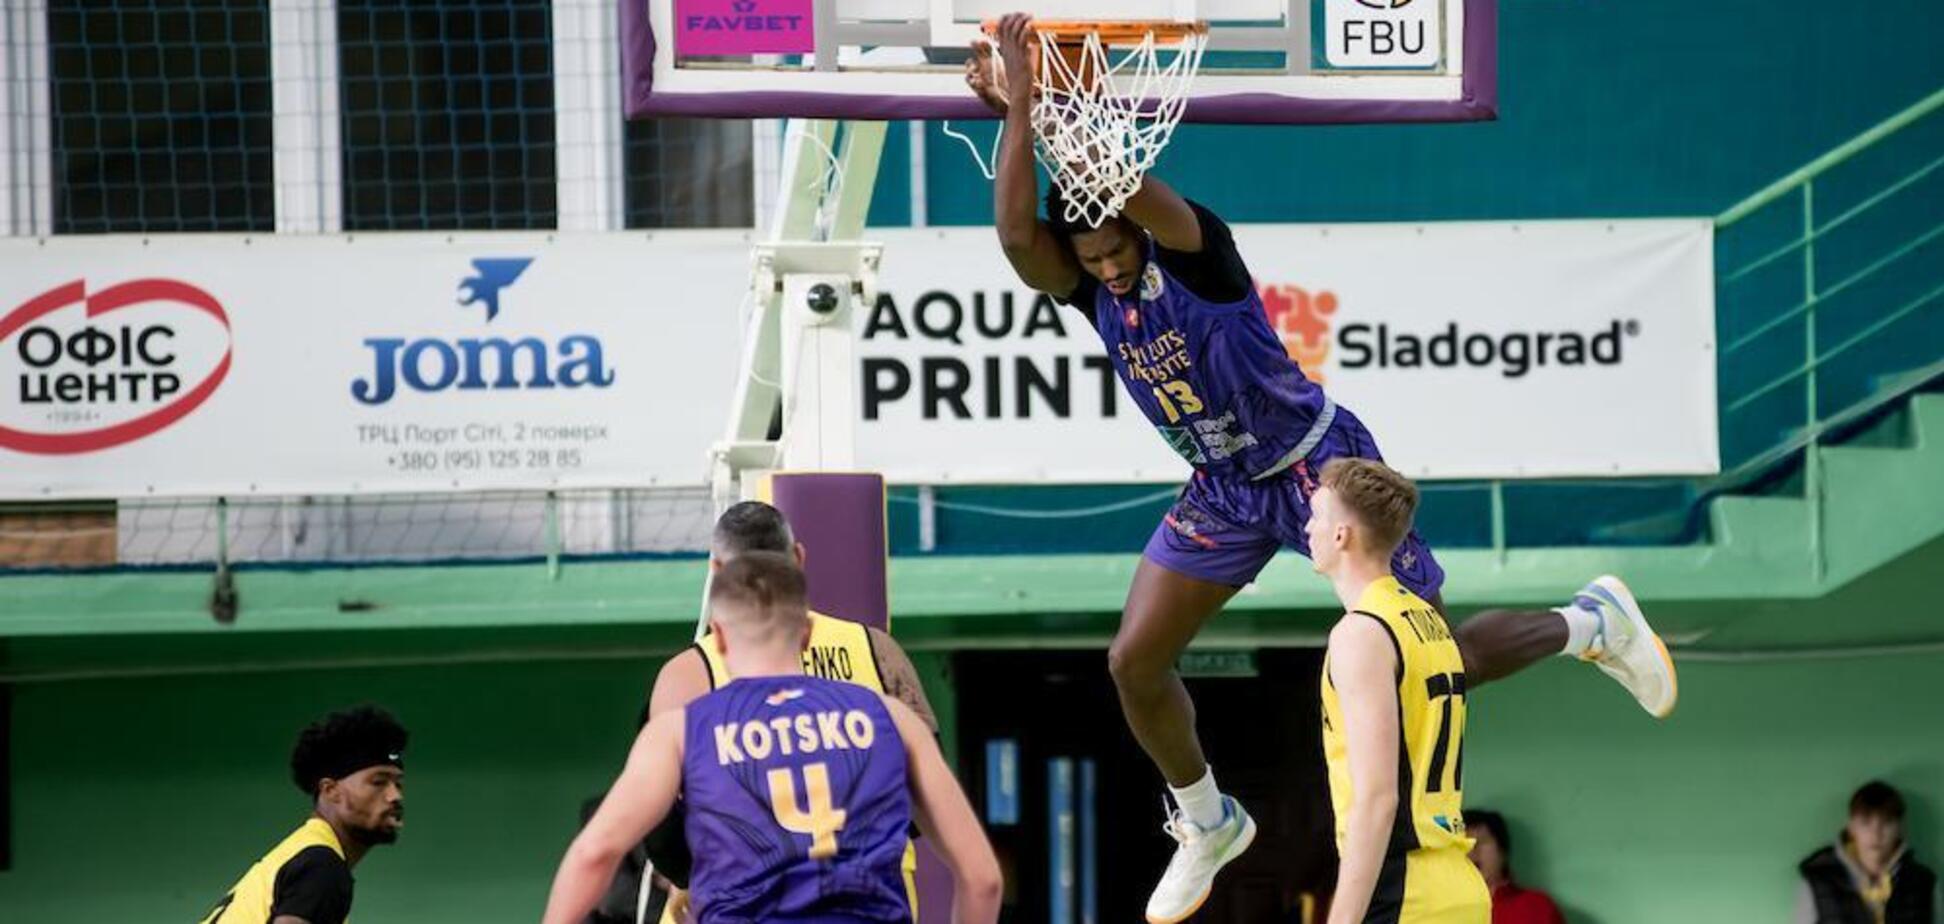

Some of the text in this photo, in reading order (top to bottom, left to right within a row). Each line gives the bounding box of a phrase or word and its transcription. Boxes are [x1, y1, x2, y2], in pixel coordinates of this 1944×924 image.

[687, 15, 802, 31] FAVBET
[1344, 20, 1424, 54] FBU
[862, 290, 1067, 344] AQUA
[18, 326, 176, 368] ОФІС
[862, 356, 1117, 419] PRINT
[1152, 380, 1203, 424] 13
[357, 425, 399, 445] ТРЦ
[404, 424, 458, 445] Порт
[514, 423, 526, 441] 2
[532, 425, 607, 443] поверх
[445, 450, 481, 470] (95)
[488, 450, 520, 469] 125
[526, 449, 549, 469] 28
[557, 449, 581, 468] 85
[714, 710, 874, 765] KOTSKO
[767, 762, 846, 859] 4
